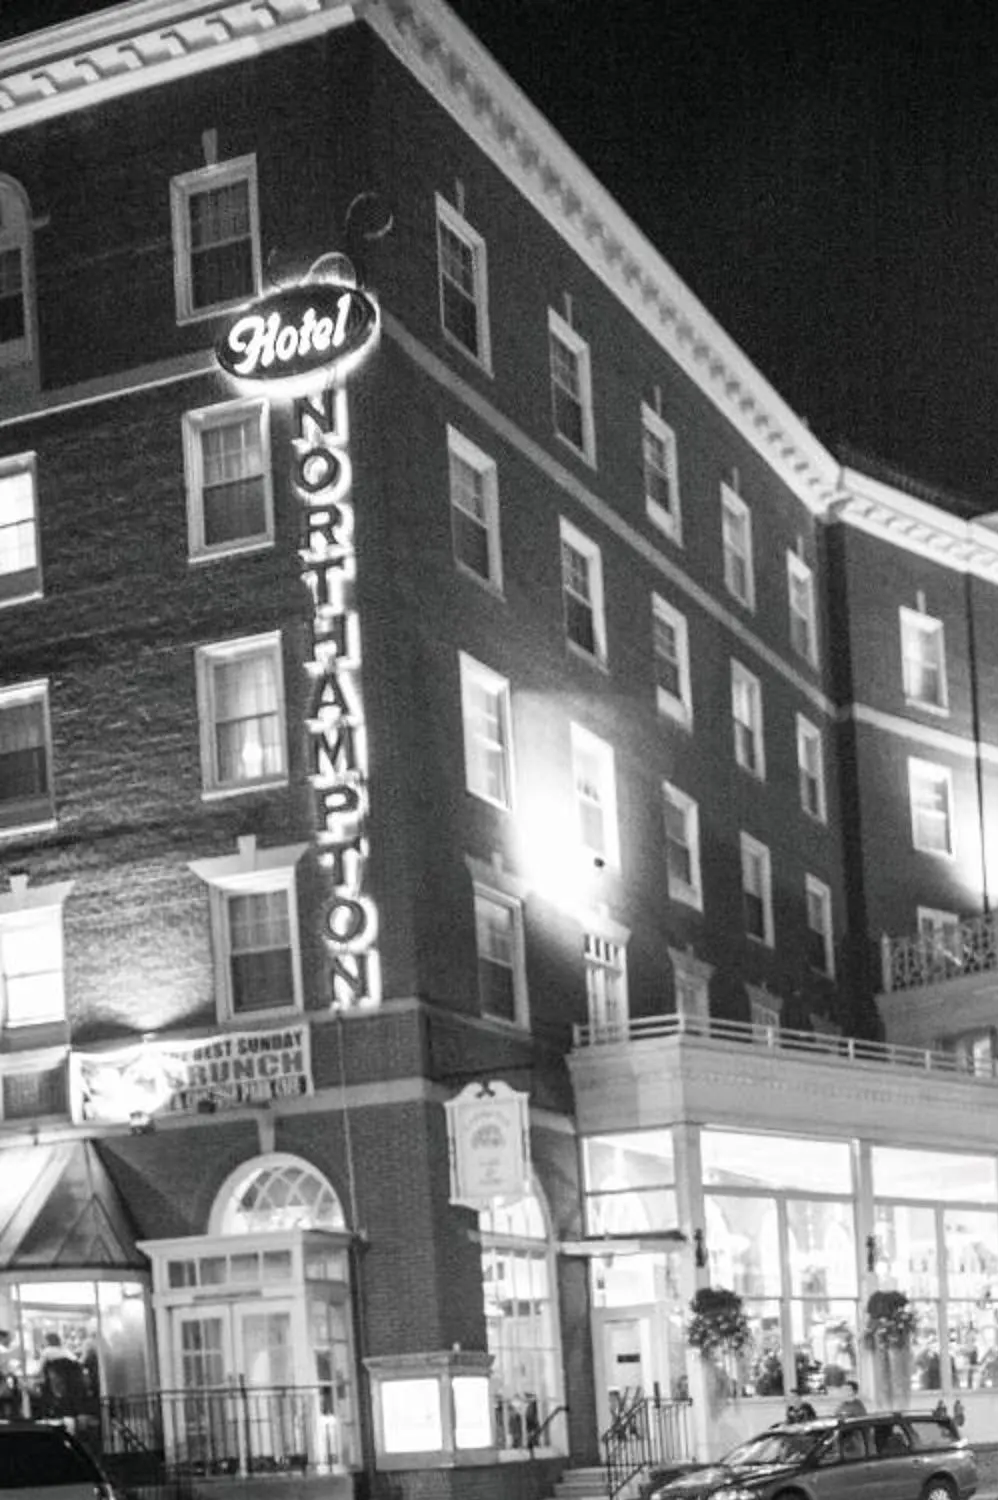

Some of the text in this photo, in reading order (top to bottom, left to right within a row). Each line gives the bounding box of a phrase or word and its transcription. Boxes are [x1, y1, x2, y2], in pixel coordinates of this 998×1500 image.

[228, 293, 352, 375] Hotel
[292, 386, 383, 1012] NORTHAMPTON
[193, 1040, 232, 1061] BEST
[237, 1030, 303, 1055] SUNDAY
